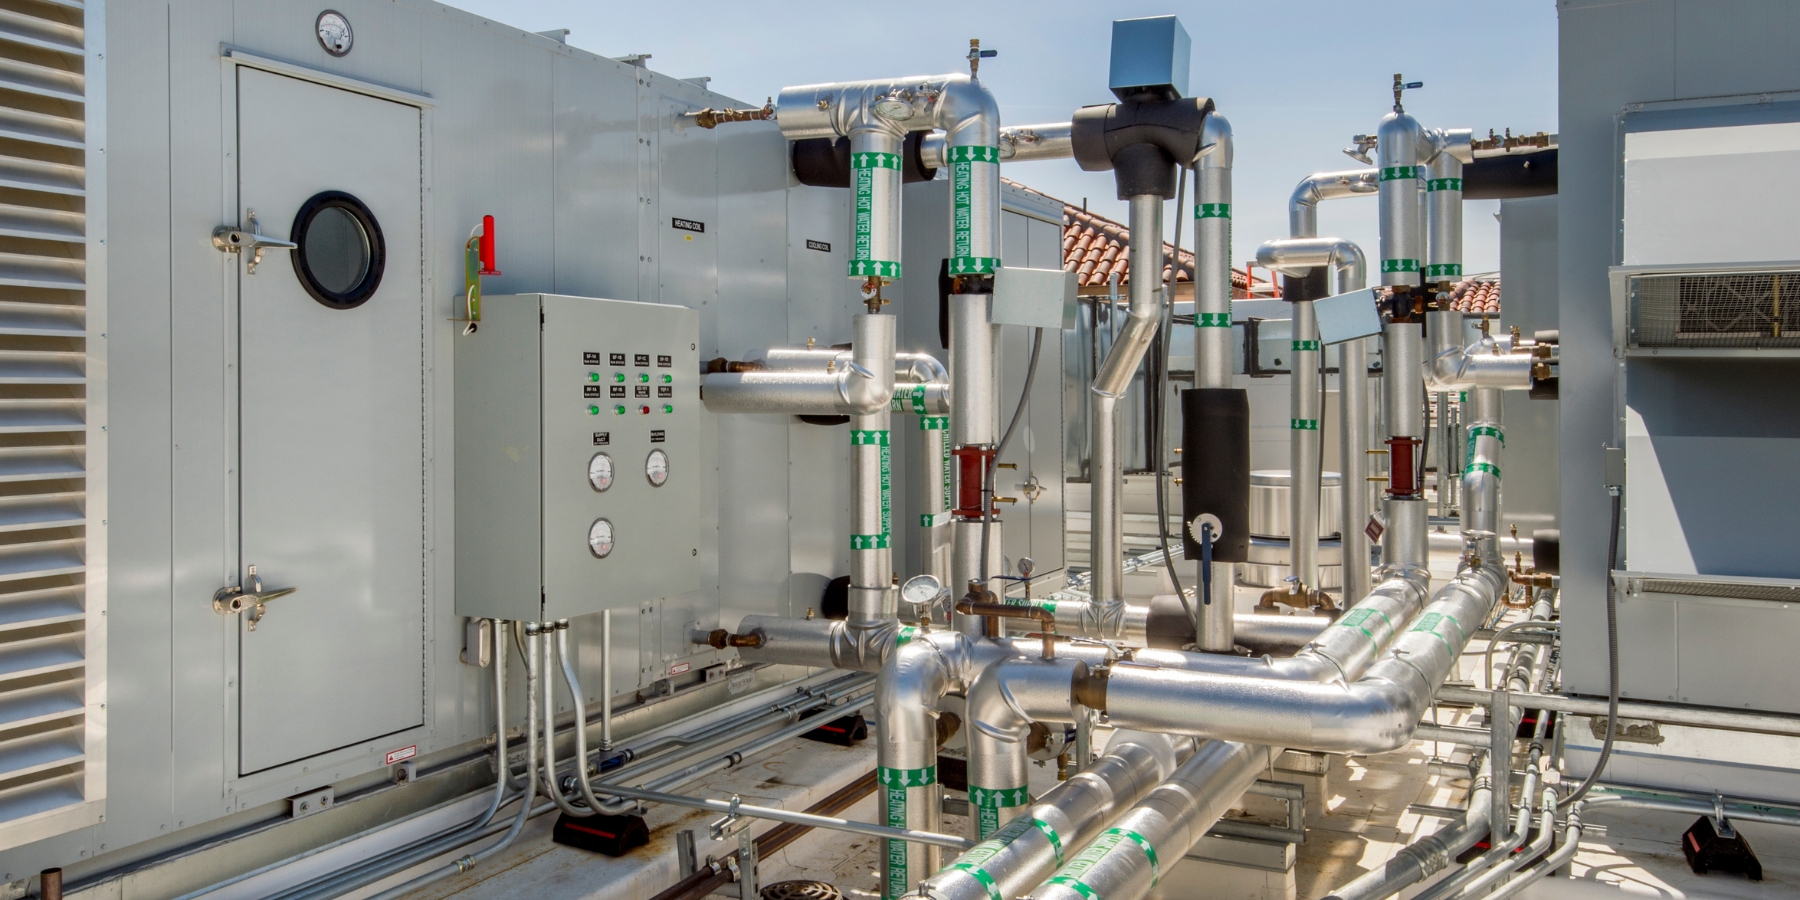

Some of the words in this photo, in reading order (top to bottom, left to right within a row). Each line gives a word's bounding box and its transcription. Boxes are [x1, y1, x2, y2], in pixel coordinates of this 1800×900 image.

[858, 168, 871, 194] HEATING
[956, 162, 970, 189] HEATING
[857, 196, 871, 210] HOT
[956, 191, 970, 205] HOT
[675, 219, 693, 229] HEATING
[692, 222, 702, 231] COIL
[857, 212, 870, 233] WATER
[956, 207, 970, 229] WATER
[856, 235, 870, 260] RETURN
[956, 231, 970, 257] RETURN
[942, 429, 951, 458] CHILLED
[881, 446, 890, 472] HEATING
[882, 474, 890, 487] HOT
[943, 460, 951, 484] WATER
[882, 489, 891, 510] WATER
[882, 511, 891, 533] SUPPLY
[889, 788, 906, 820] HEATING
[890, 840, 906, 865] WATER
[890, 867, 906, 897] RETURN
